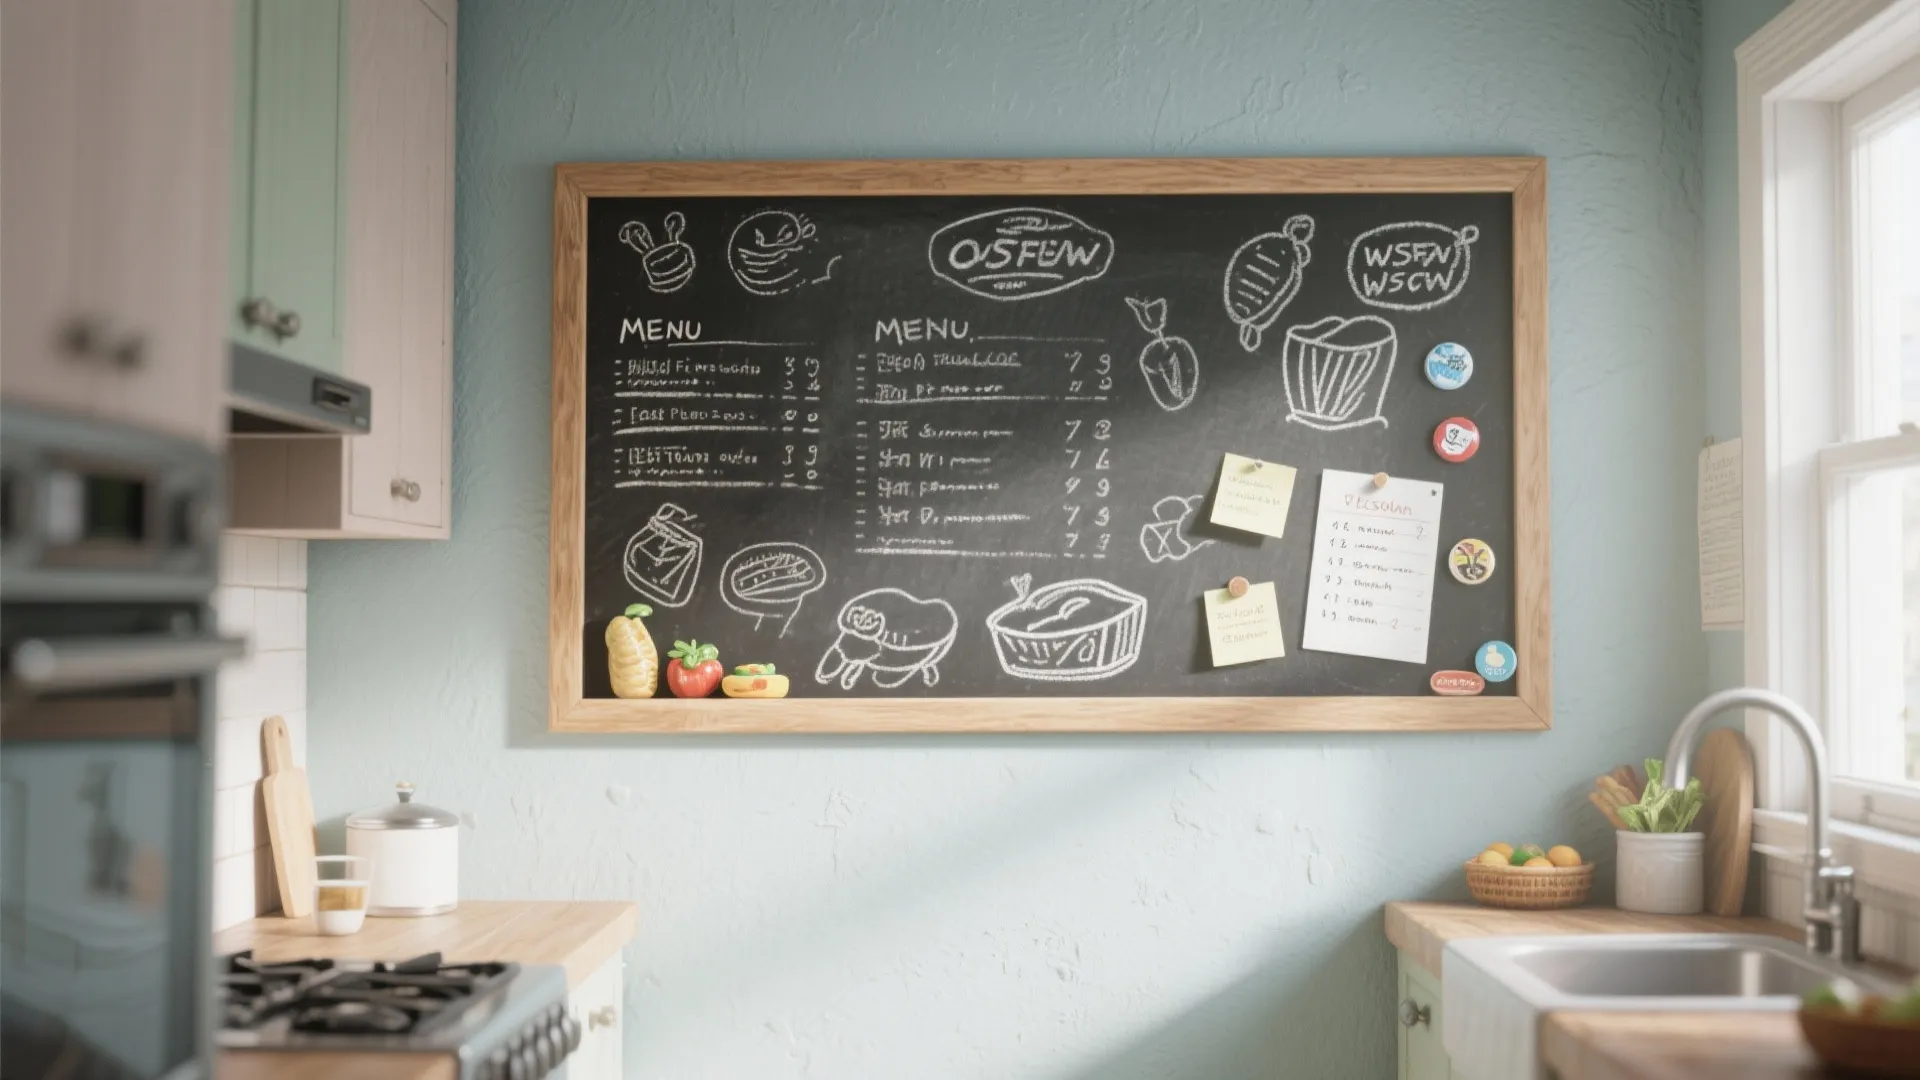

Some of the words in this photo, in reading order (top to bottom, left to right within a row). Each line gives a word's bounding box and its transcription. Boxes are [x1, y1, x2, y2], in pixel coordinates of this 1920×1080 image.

[619, 317, 702, 344] MENU
[1064, 419, 1082, 441] 7
[1065, 448, 1081, 469] 7
[1095, 477, 1110, 498] 9
